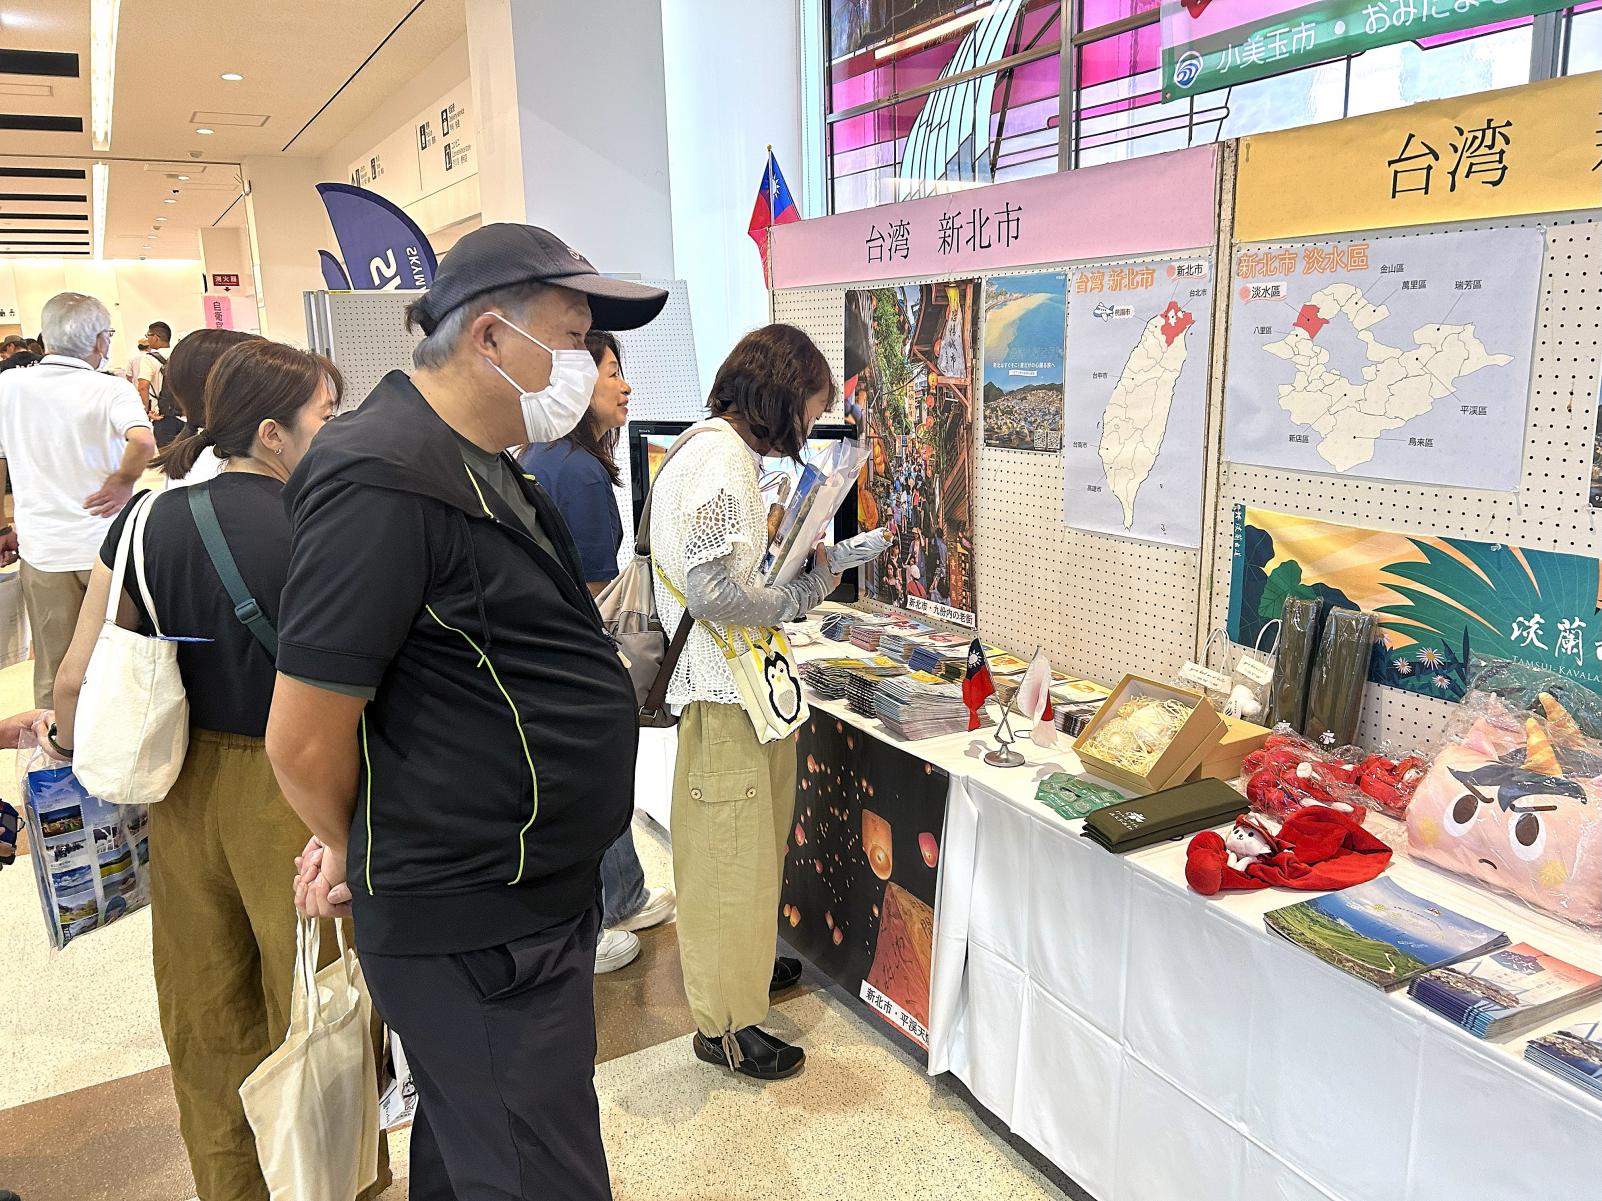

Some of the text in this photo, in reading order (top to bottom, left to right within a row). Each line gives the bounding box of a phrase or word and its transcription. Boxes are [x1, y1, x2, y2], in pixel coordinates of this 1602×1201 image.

[1387, 118, 1513, 199] 台湾
[866, 202, 1022, 263] 台湾 新北市
[1176, 264, 1204, 278] 新北市
[1238, 244, 1369, 279] 新北市 淡水區
[1107, 266, 1156, 292] 新北市
[1454, 279, 1482, 290] 瑞芳區
[1189, 288, 1207, 298] 台北市
[1251, 285, 1281, 299] 淡水區
